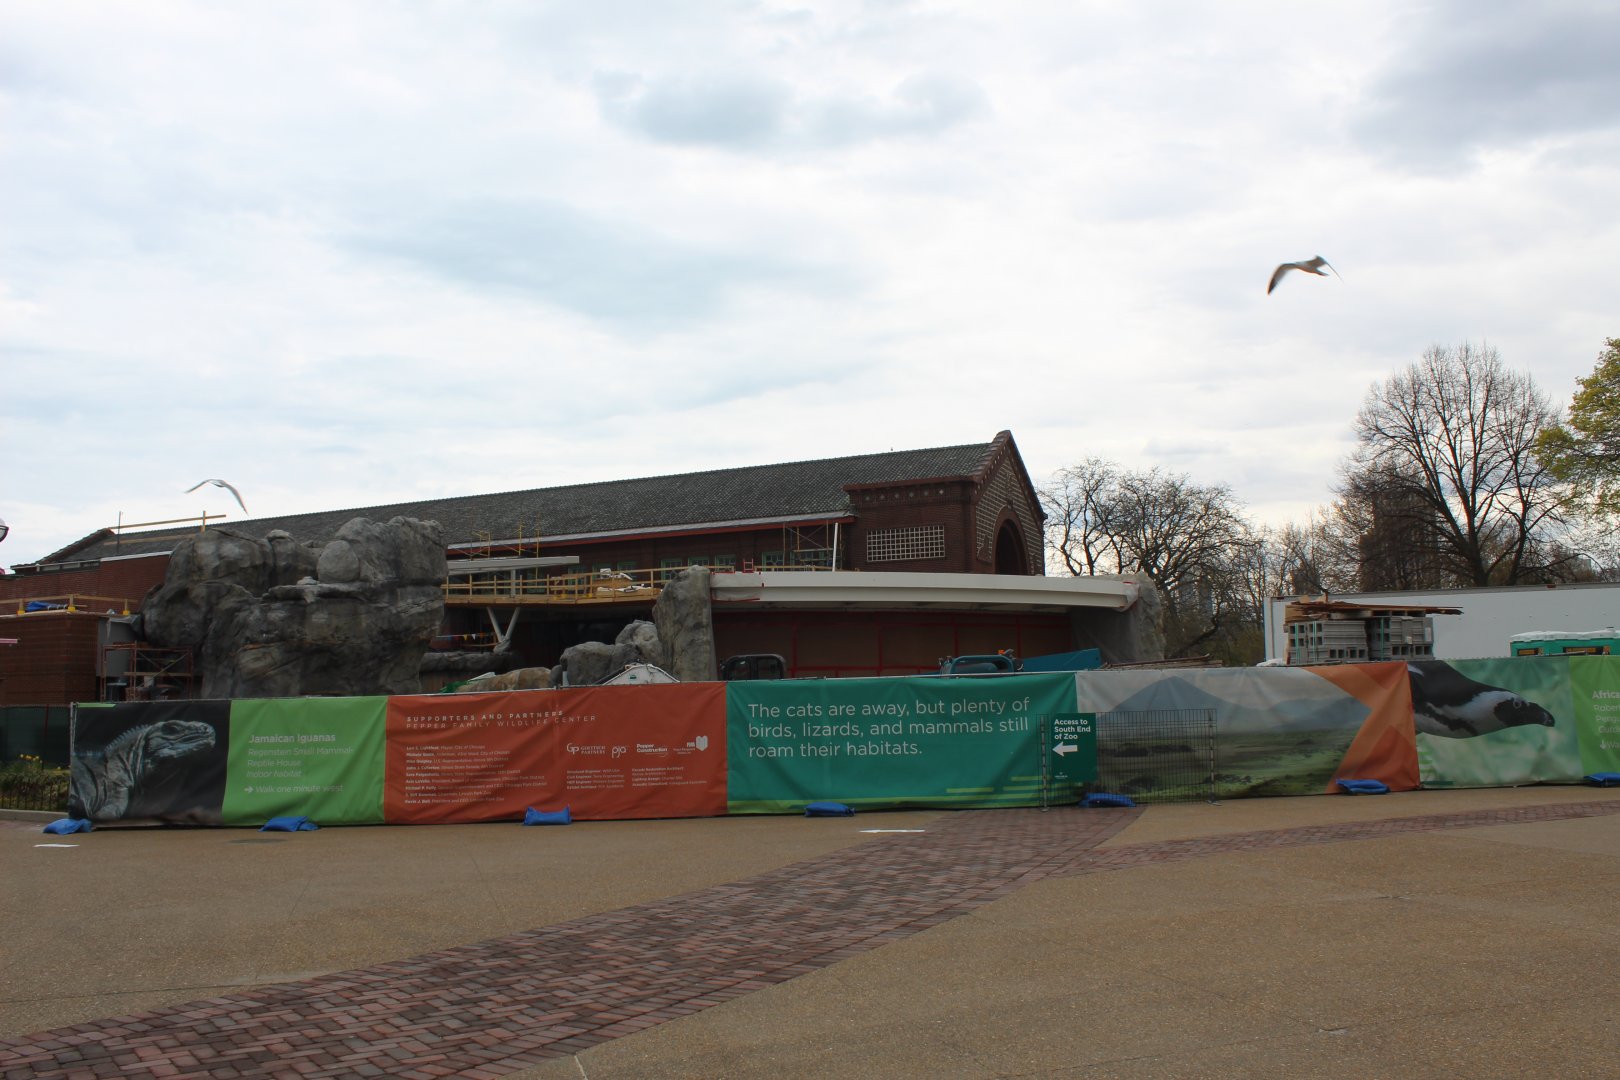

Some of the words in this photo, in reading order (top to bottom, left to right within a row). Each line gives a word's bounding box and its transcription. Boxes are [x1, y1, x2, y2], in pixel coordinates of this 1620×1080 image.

[748, 703, 780, 718] The
[786, 703, 822, 717] cats
[828, 704, 856, 716] are
[861, 703, 910, 717] away,
[916, 699, 945, 714] but
[951, 698, 1006, 716] plenty
[1012, 696, 1030, 712] of
[406, 714, 475, 722] SUPPORTERS
[481, 712, 502, 720] AND
[509, 710, 563, 718] PARTNERS
[497, 718, 548, 727] WILDLIFE
[554, 715, 596, 724] CENTER
[748, 722, 796, 739] birds,
[803, 721, 864, 738] lizards,
[870, 720, 903, 735] and
[909, 718, 993, 735] mammals
[999, 716, 1029, 732] still
[1077, 725, 1091, 733] End
[248, 734, 295, 743] Jamaican
[297, 734, 336, 744] Iguanas
[248, 748, 291, 757] Regenstein
[293, 747, 315, 755] Small
[749, 746, 794, 758] roam
[800, 742, 840, 757] their
[847, 740, 923, 756] habitats.
[247, 759, 275, 768] Reptile
[276, 759, 302, 767] House
[246, 770, 272, 778] Indoor
[273, 770, 302, 778] habitat
[255, 785, 274, 793] Walk
[276, 785, 291, 793] one
[293, 784, 321, 792] minute
[323, 784, 344, 792] west
